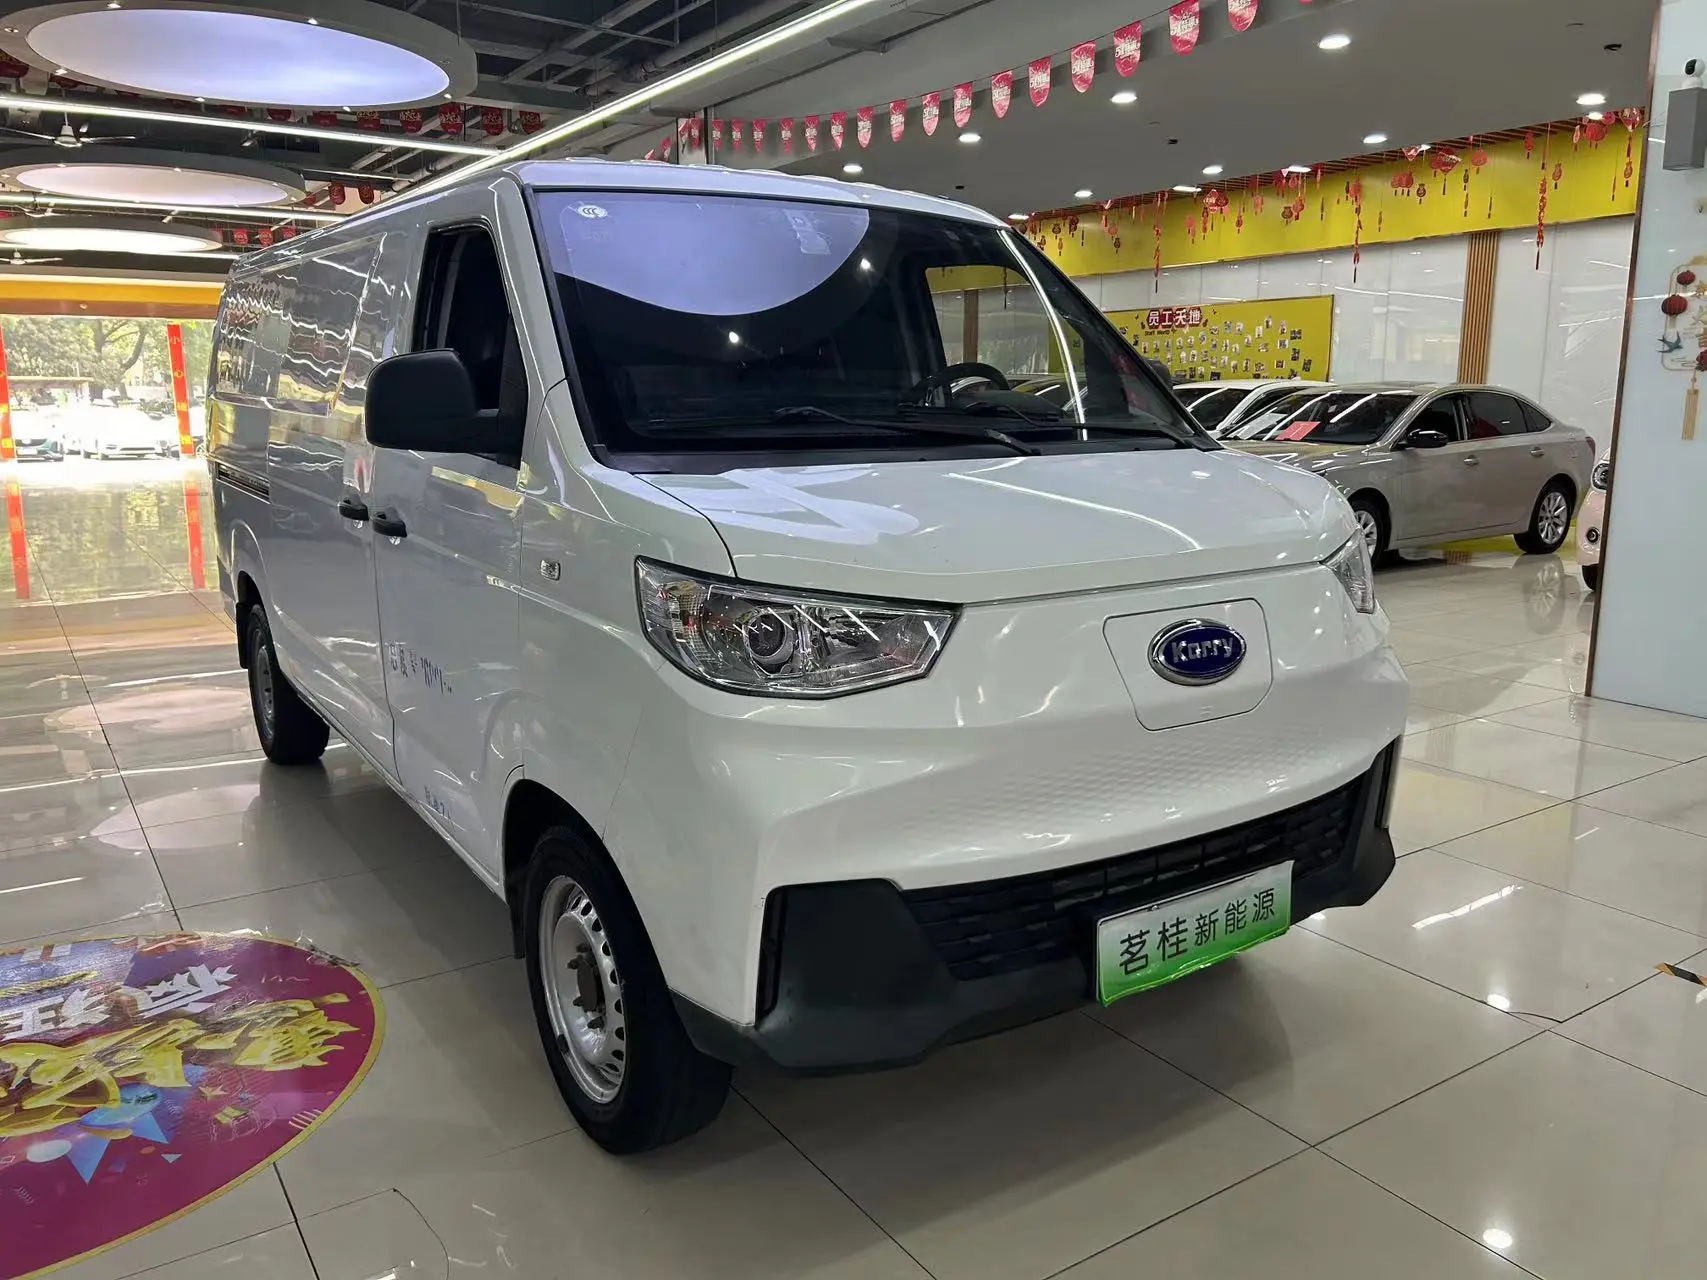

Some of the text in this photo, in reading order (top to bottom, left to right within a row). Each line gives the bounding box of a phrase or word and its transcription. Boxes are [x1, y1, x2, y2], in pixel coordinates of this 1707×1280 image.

[1148, 309, 1200, 326] 员工天地
[1171, 637, 1234, 664] Karry
[1118, 887, 1276, 976] 茗桂新能源
